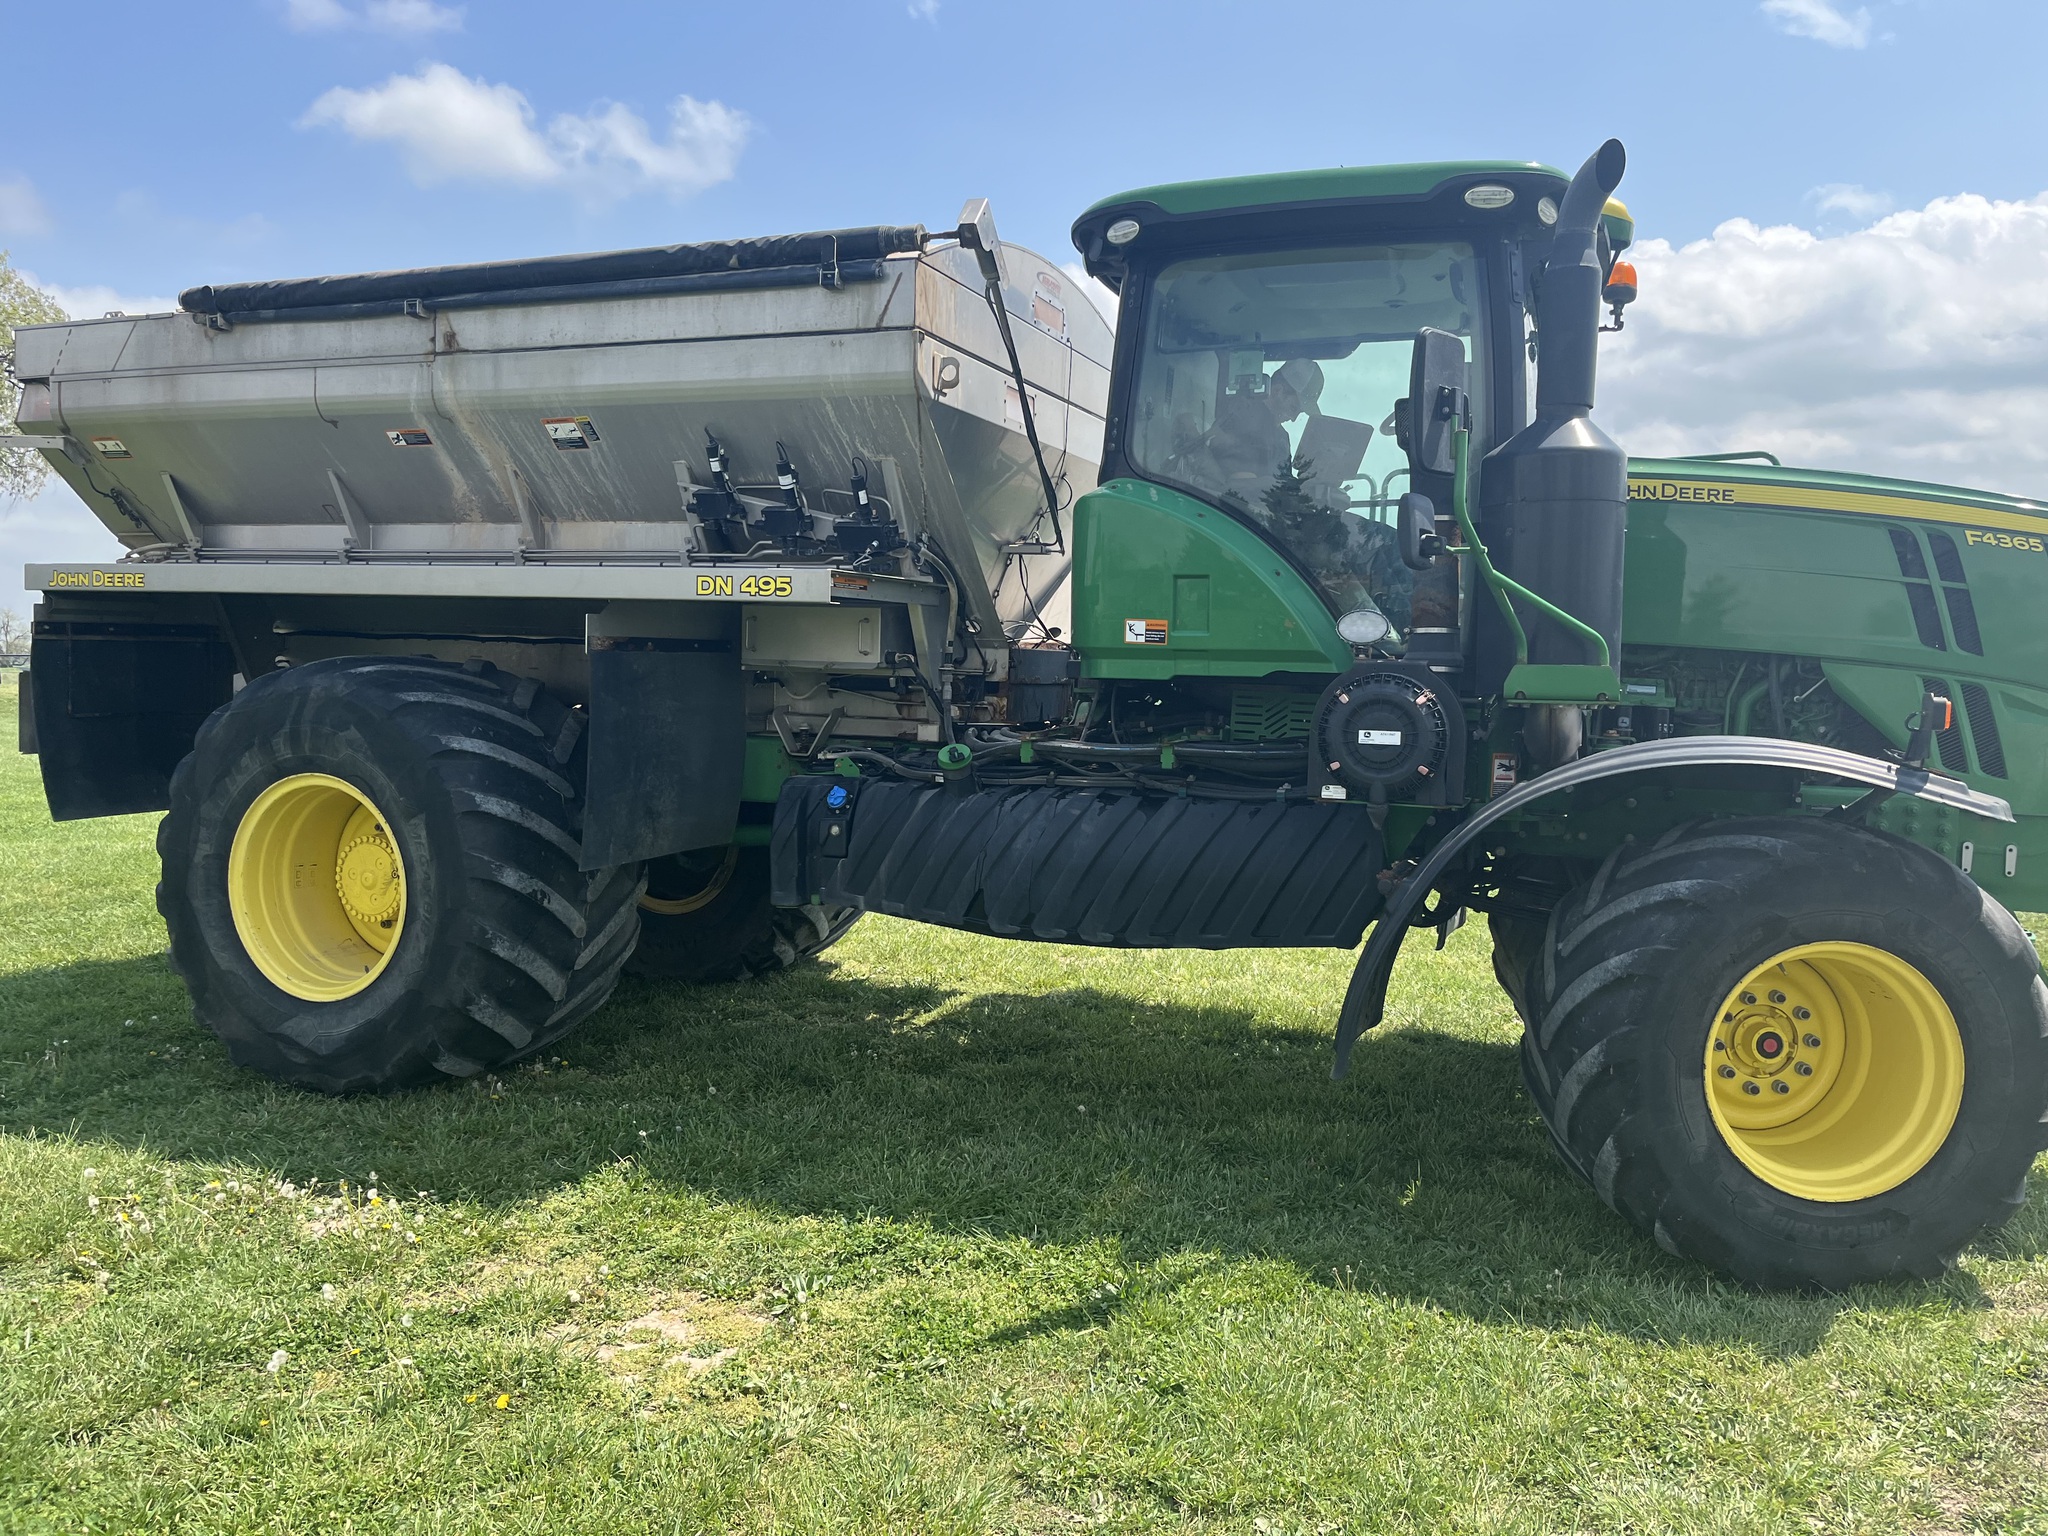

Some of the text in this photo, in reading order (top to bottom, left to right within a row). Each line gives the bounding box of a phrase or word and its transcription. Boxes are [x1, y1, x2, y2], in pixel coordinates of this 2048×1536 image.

[1627, 483, 1735, 502] HN DEERE
[1964, 529, 2044, 553] F4365
[49, 570, 145, 587] JOHN DEERE
[696, 575, 792, 597] DN 495
